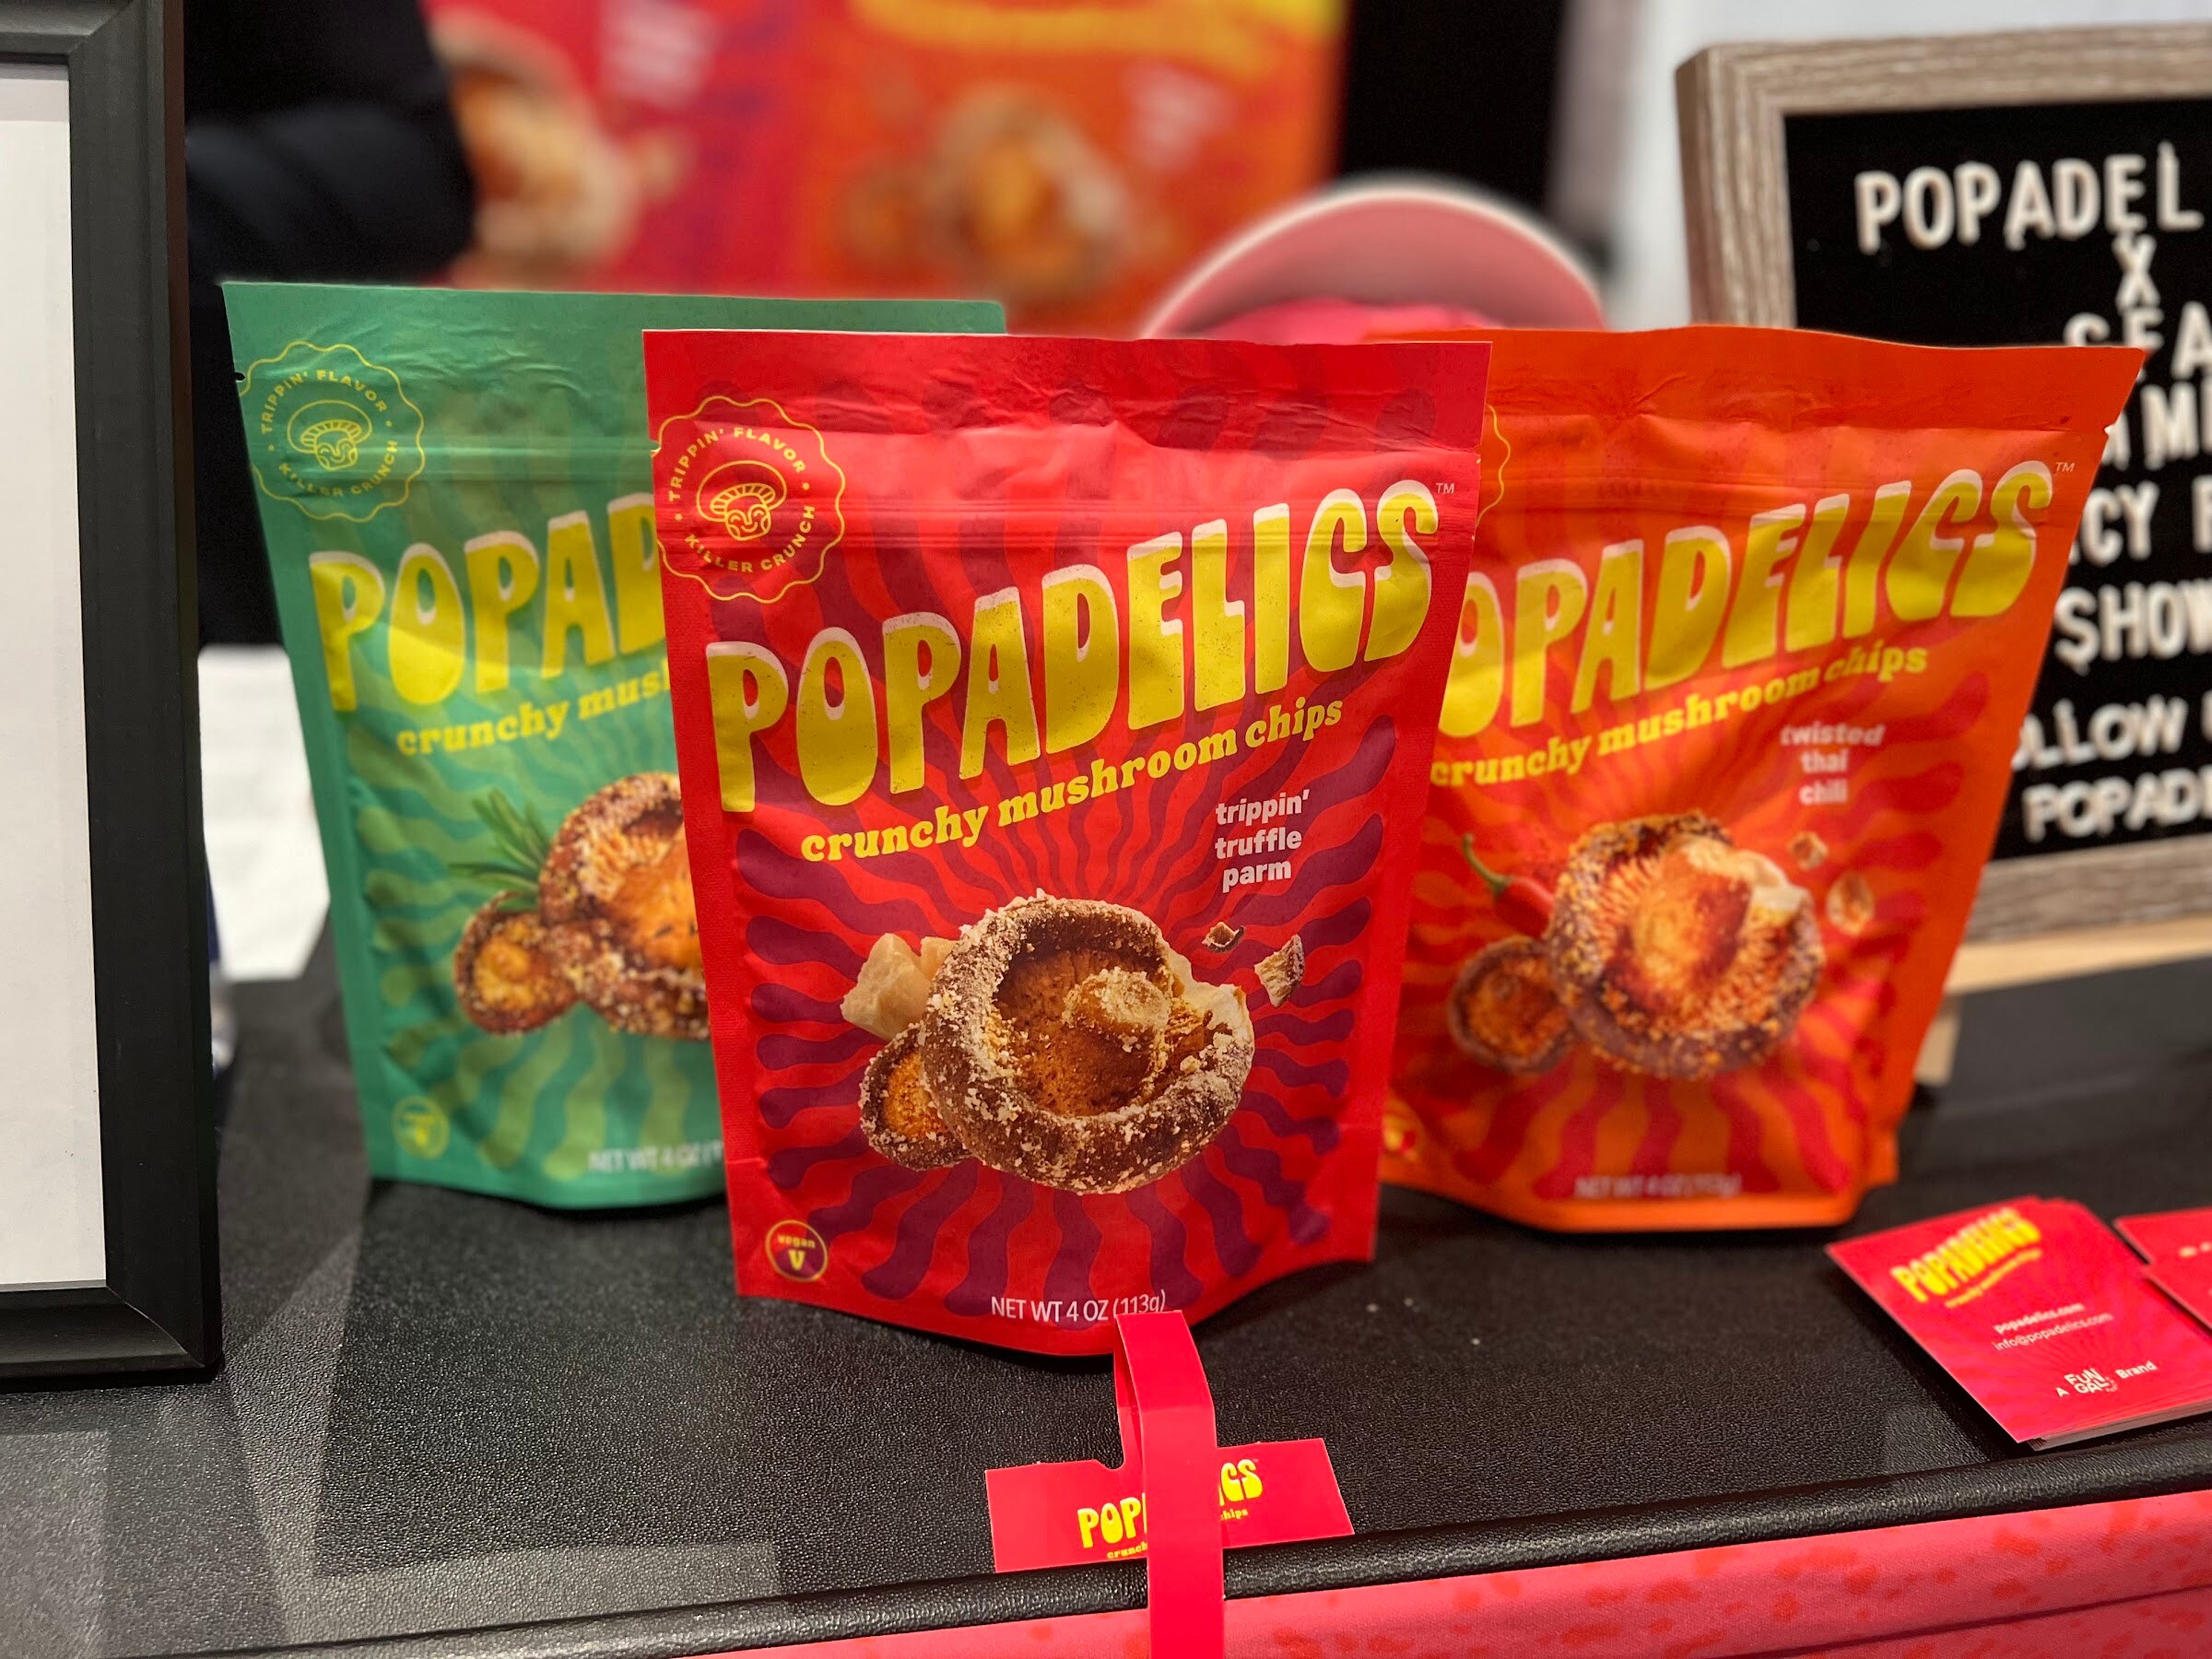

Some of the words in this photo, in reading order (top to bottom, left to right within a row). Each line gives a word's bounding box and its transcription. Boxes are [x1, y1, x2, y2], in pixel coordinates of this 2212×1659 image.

[1854, 141, 2205, 256] POPADEL
[2112, 232, 2161, 315] X
[261, 371, 308, 435] TRIPPIN'
[316, 370, 387, 413] FLAVOR
[350, 440, 398, 496] CRUNCH
[668, 428, 724, 502] TRIPPIN'
[734, 427, 806, 474] FLAVOR
[685, 534, 754, 573] KILLER
[760, 506, 816, 571] CRUNCH
[705, 479, 1440, 813] POPADELICS
[397, 700, 571, 757] crunchy
[1430, 735, 1593, 786] crunchy
[1598, 665, 1821, 755] mushroom
[1823, 640, 1927, 682] chips
[1780, 721, 1887, 747] twisted
[1800, 747, 1849, 774] thai
[801, 805, 989, 863] crunchy
[996, 729, 1240, 827] mushroom
[1243, 697, 1343, 748] chips
[1798, 778, 1848, 806] chili
[1215, 789, 1310, 825] trippin'
[1215, 830, 1302, 860] truffle
[1222, 861, 1290, 892] parm
[777, 1235, 816, 1249] vegan
[788, 1249, 806, 1270] V
[991, 1296, 1026, 1319] NET
[1030, 1300, 1063, 1322] WT
[1065, 1300, 1078, 1322] 4
[1083, 1300, 1109, 1321] OZ
[1994, 1302, 2085, 1335] popadelics.com
[1992, 1312, 2114, 1351] info@popadelics.com
[2055, 1385, 2070, 1397] A
[2114, 1360, 2159, 1380] Brand
